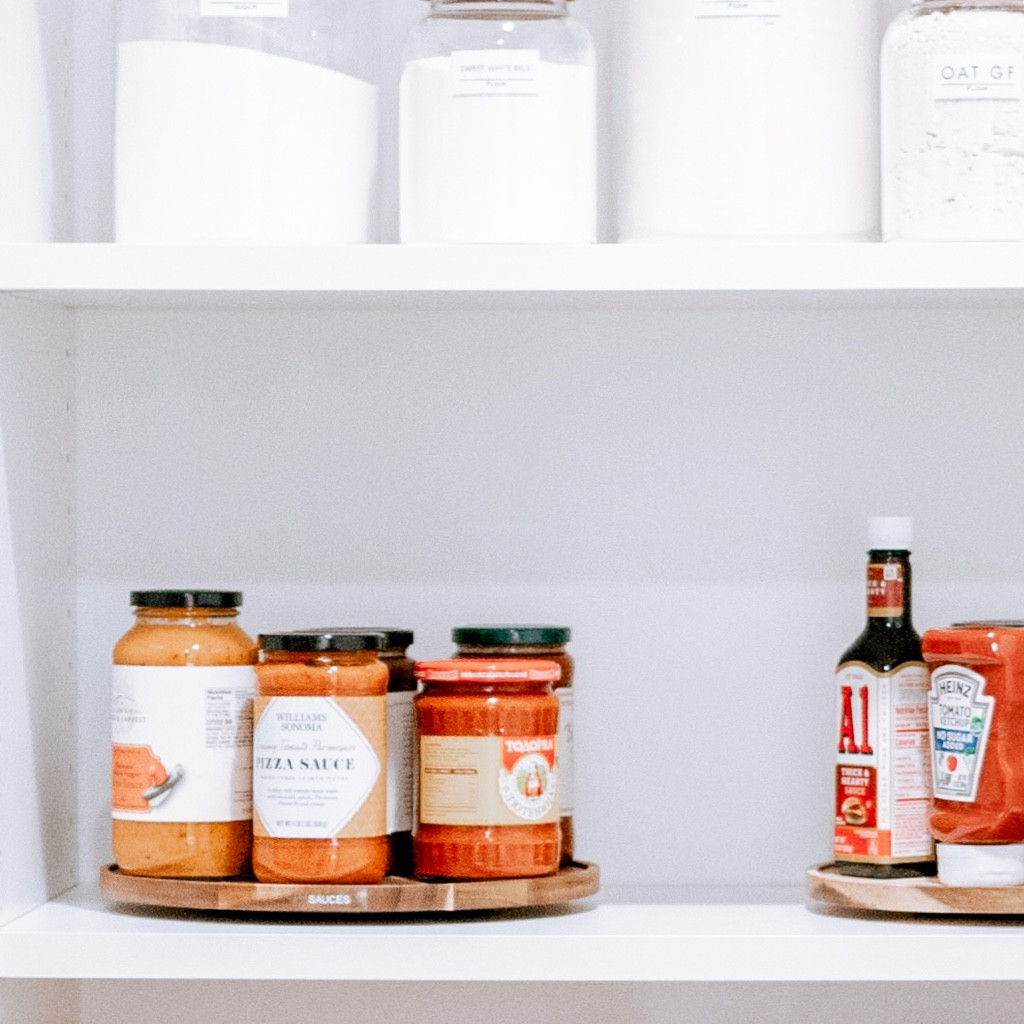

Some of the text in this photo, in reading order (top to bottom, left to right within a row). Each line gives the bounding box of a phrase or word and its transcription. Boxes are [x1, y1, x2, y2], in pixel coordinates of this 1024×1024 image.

[941, 65, 1015, 80] OAT GF
[940, 680, 972, 698] HEINZ
[276, 712, 328, 723] WILLIAMS
[939, 704, 972, 719] TOMATO
[281, 722, 323, 733] SONOMA
[256, 756, 356, 771] PIZZA SAUCE
[308, 894, 351, 905] SAUCES
